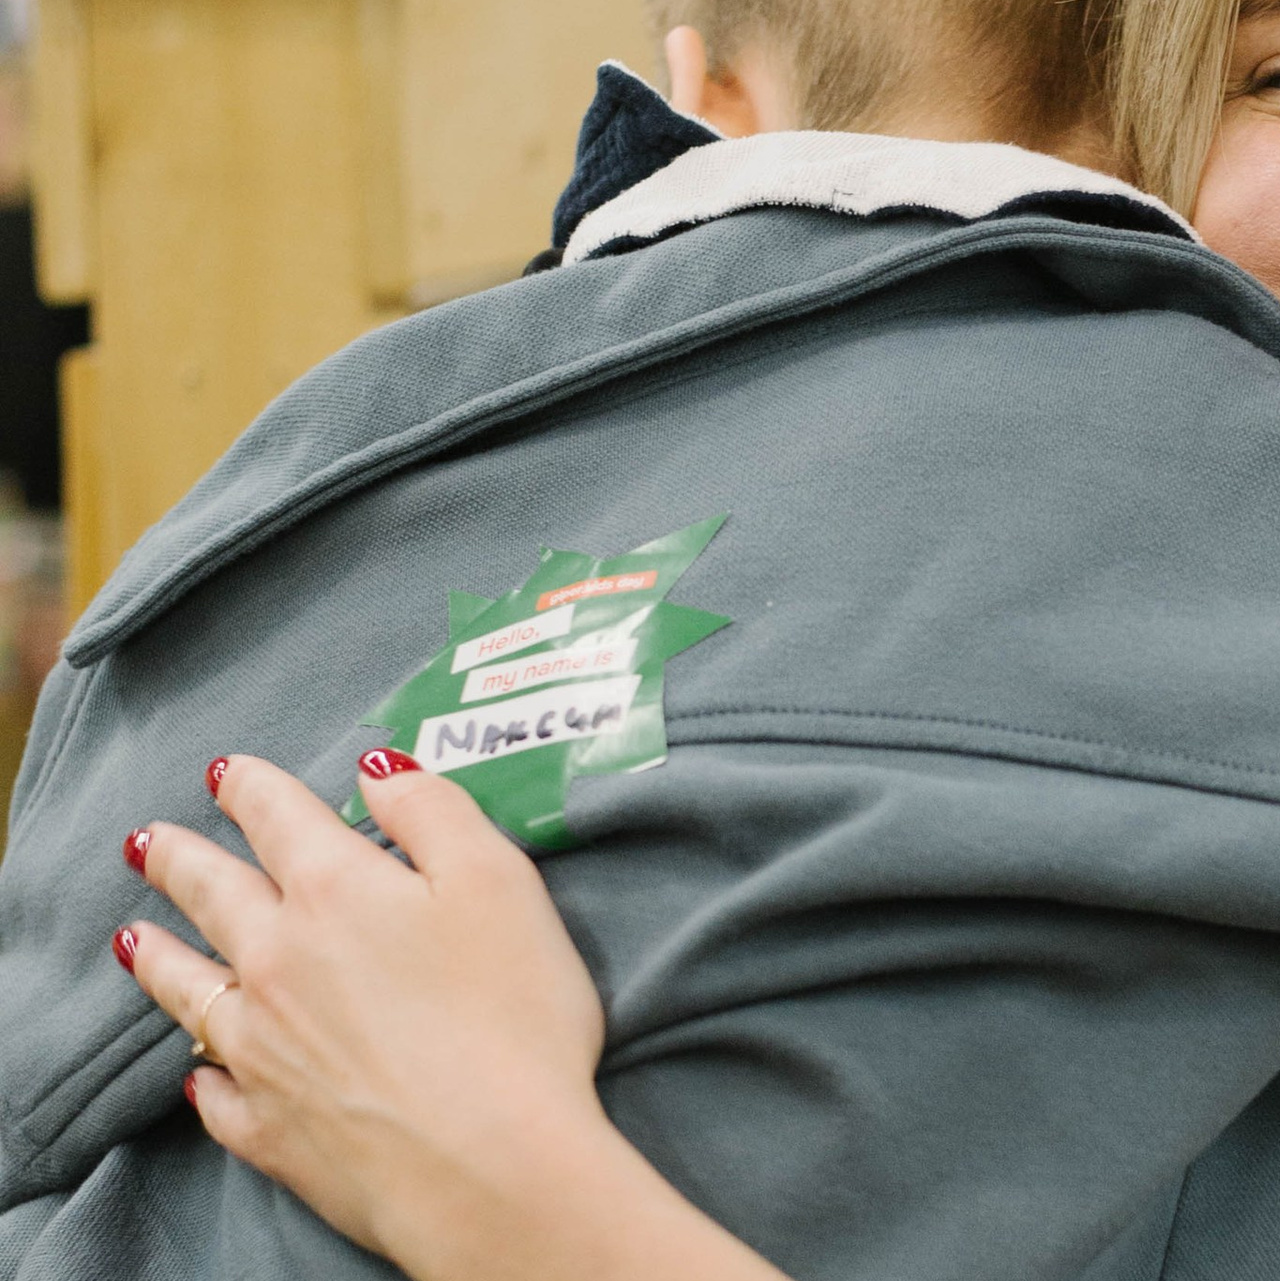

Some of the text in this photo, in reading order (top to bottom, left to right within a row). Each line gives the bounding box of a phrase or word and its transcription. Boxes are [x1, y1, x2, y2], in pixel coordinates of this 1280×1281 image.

[477, 625, 540, 657] Hello,
[482, 649, 614, 692] my name is
